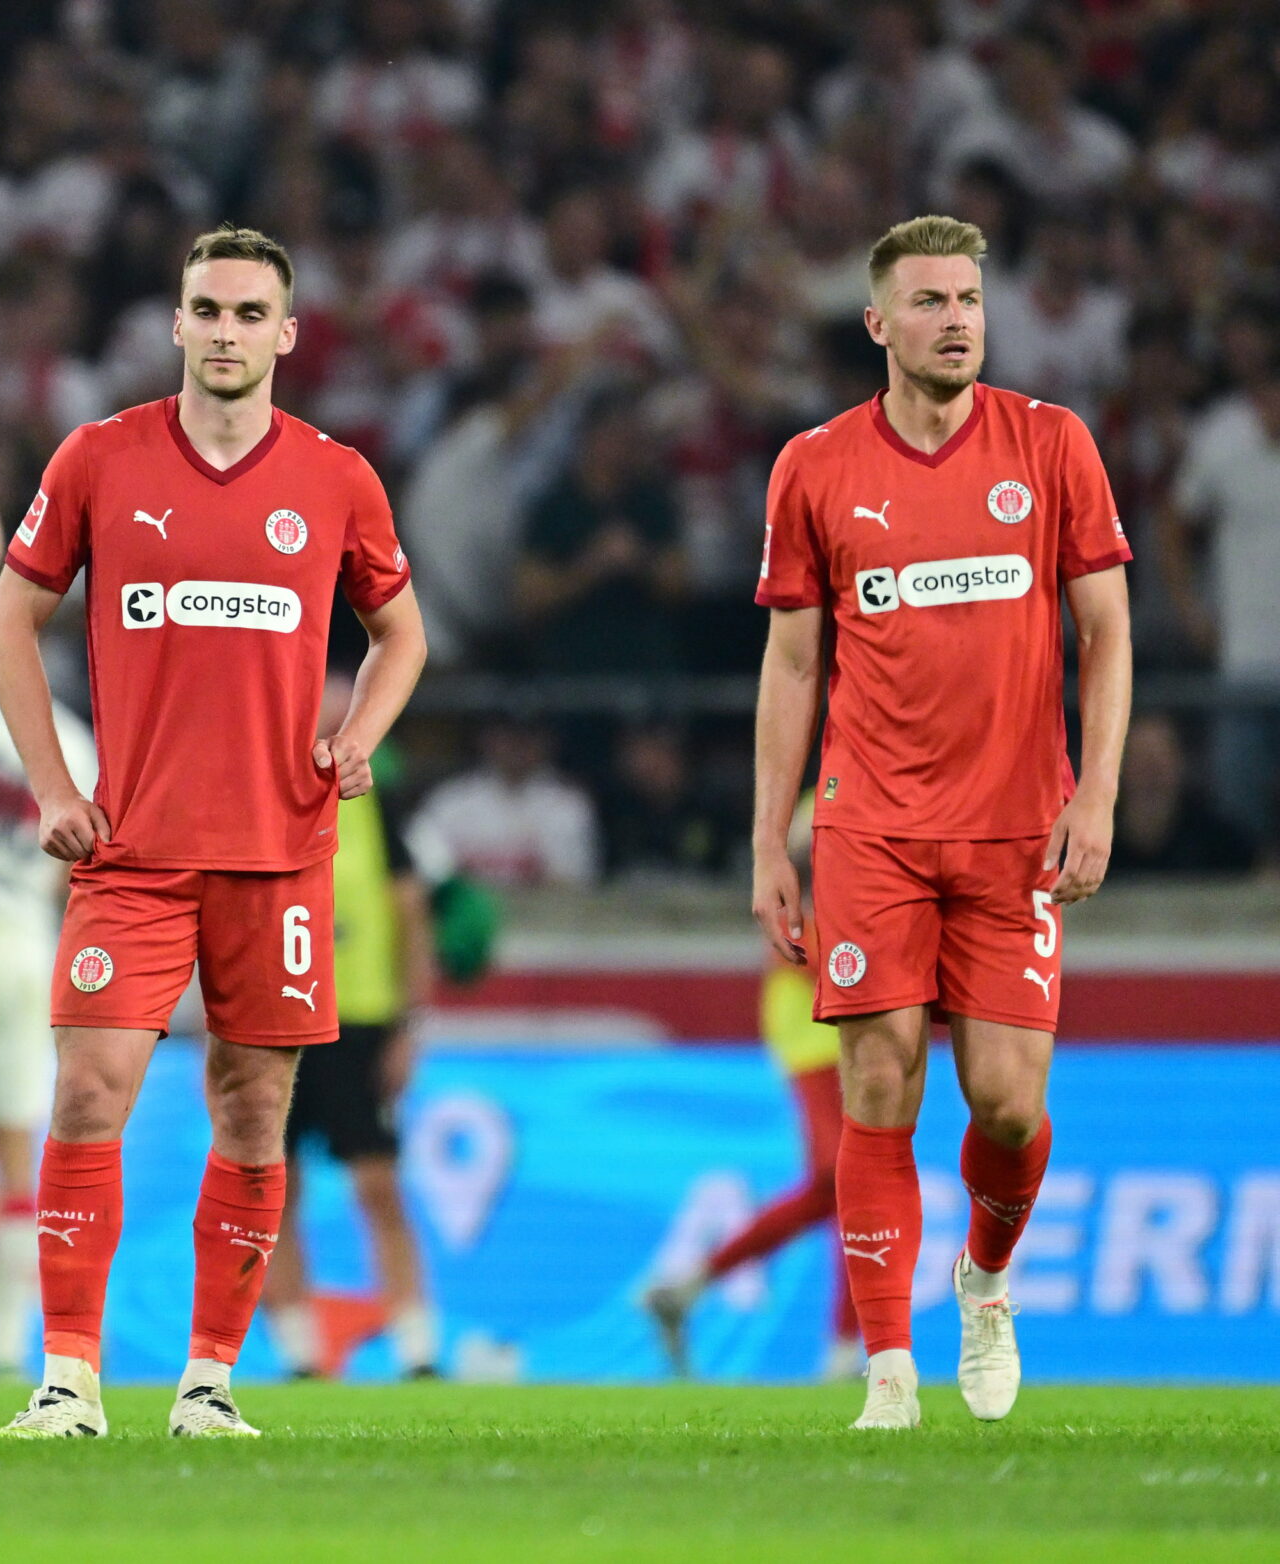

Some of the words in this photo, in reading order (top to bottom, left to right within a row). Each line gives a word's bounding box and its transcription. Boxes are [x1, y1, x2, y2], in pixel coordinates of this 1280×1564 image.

[287, 511, 306, 534] PAULI
[912, 566, 1021, 594] congstar
[180, 594, 291, 619] congstar
[1032, 889, 1057, 958] 5
[283, 905, 312, 975] 6
[93, 948, 112, 971] PAULI
